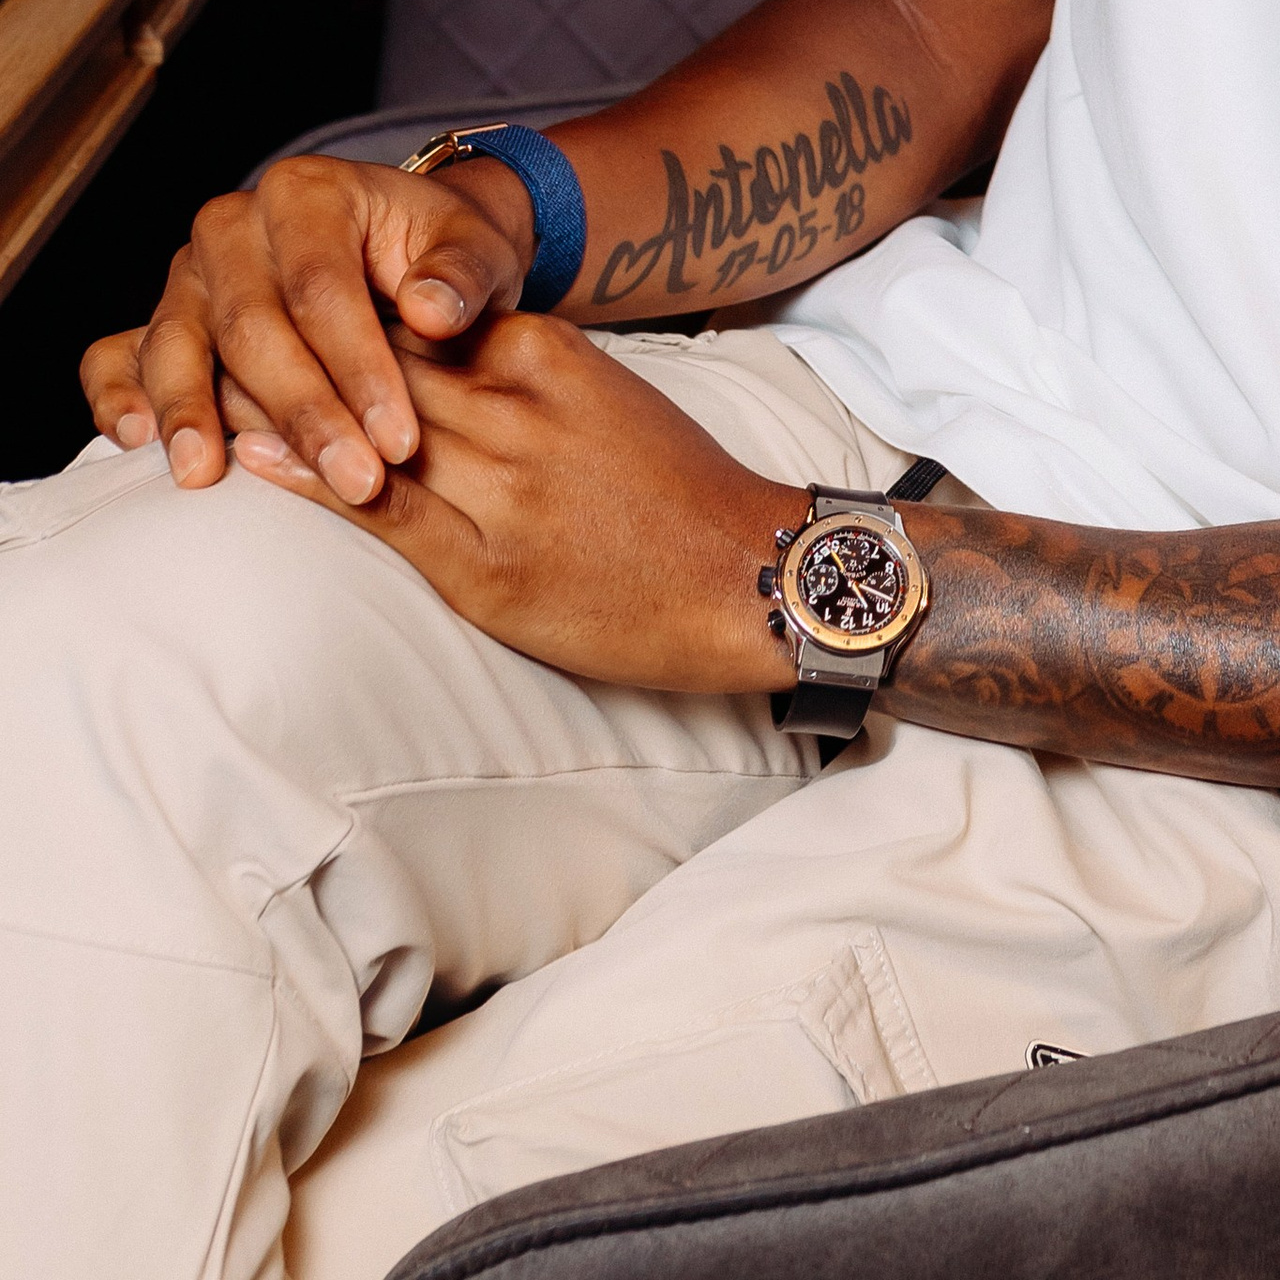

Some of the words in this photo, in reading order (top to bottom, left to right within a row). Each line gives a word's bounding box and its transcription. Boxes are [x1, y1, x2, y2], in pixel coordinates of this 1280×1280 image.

[592, 71, 912, 306] Antonella
[710, 183, 865, 295] 17-05-18
[870, 545, 880, 559] 7
[885, 561, 895, 575] 8
[824, 607, 832, 621] 1
[876, 601, 892, 614] 10
[840, 615, 856, 630] 12
[862, 612, 875, 627] 11
